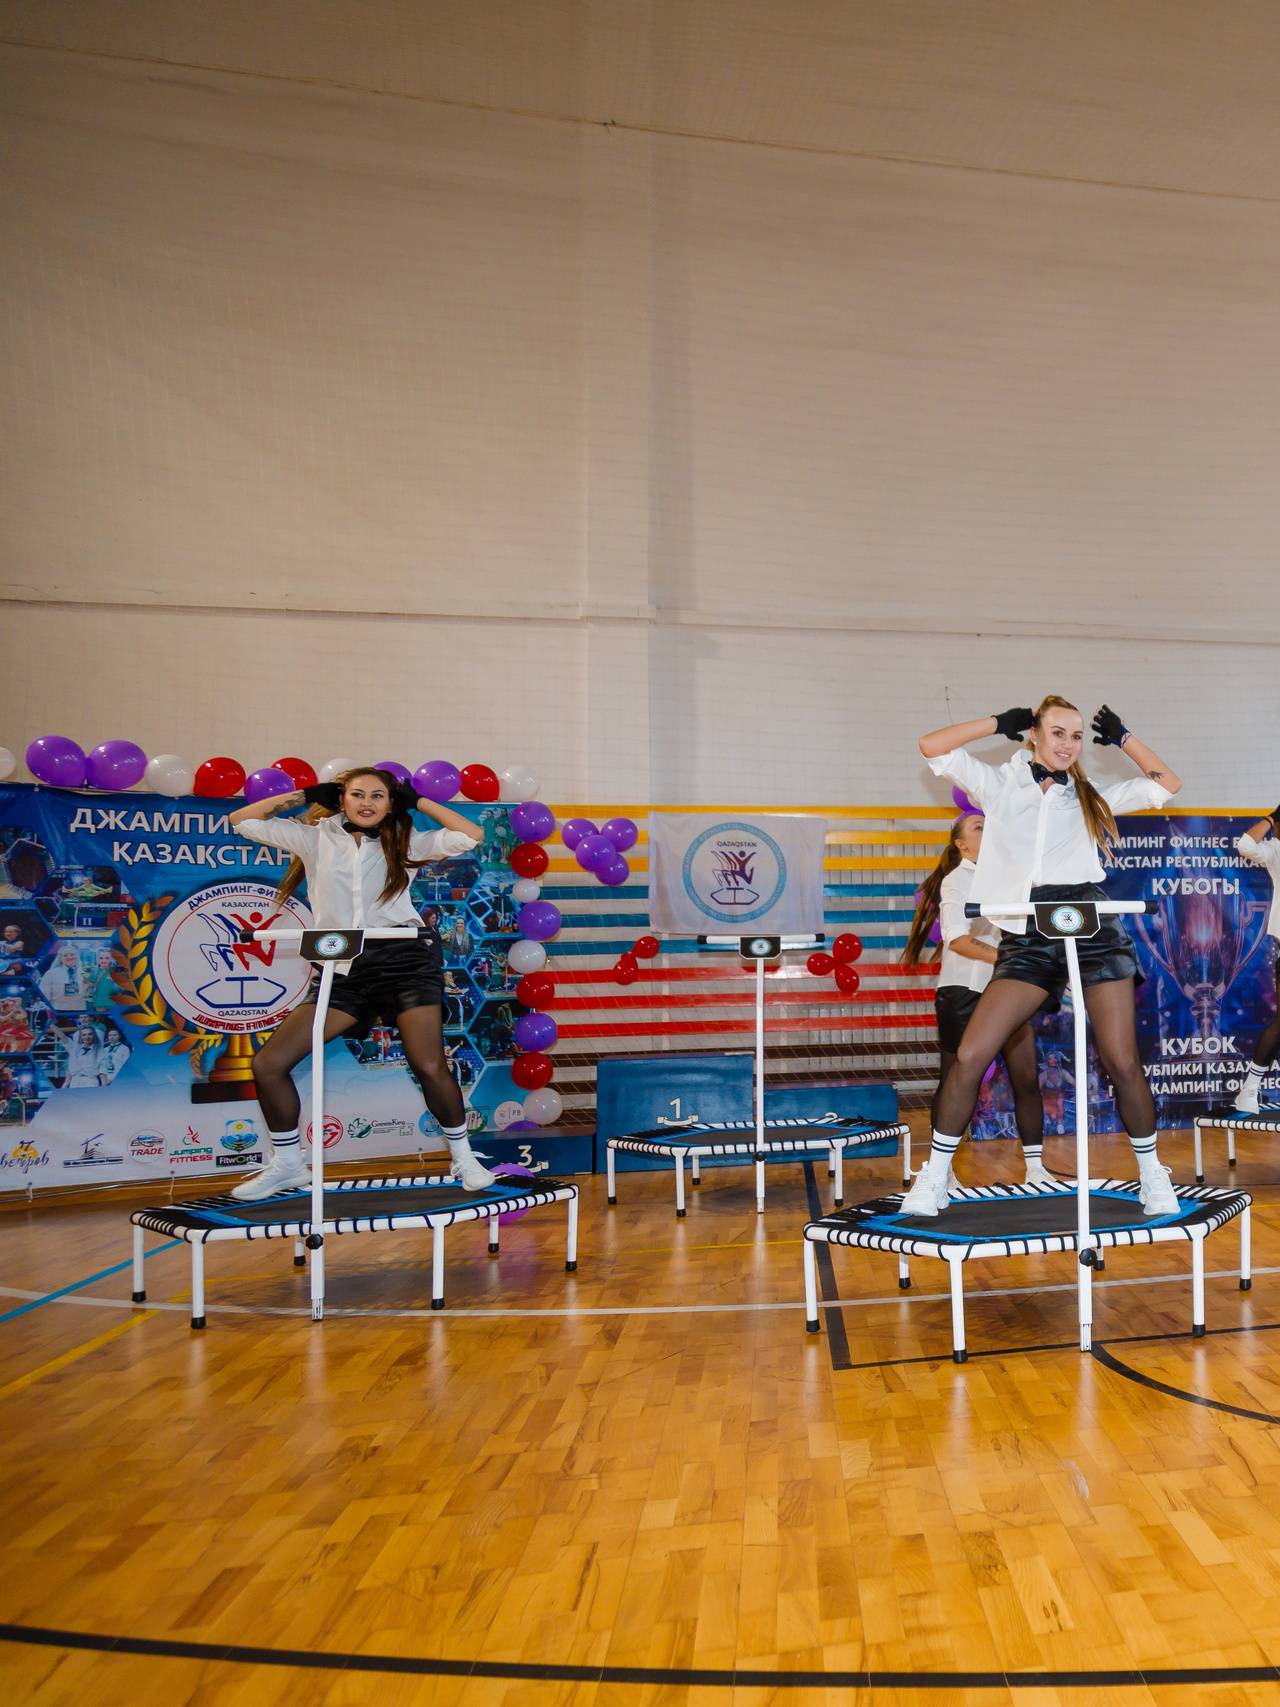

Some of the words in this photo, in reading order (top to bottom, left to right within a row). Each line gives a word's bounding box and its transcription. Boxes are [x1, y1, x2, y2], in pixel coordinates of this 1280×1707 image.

[69, 808, 240, 835] ДЖАМПИ
[1104, 836, 1167, 848] АМПИНГ
[1170, 836, 1228, 848] ФИТНЕС
[113, 841, 294, 869] ҚАЗАҚСТАН
[1152, 878, 1240, 896] КУБОГЫ
[187, 885, 299, 911] ДЖАМПИНГ-ФИТЕС
[192, 1014, 245, 1031] JUMPING
[246, 1008, 291, 1031] FITNESS
[218, 1009, 268, 1017] QAZAQSTAN
[1161, 1036, 1238, 1056] КУБОК
[1142, 1062, 1203, 1078] УБЛИКИ
[669, 1098, 681, 1119] 1
[130, 1148, 164, 1156] TRADE
[517, 1145, 532, 1166] 3
